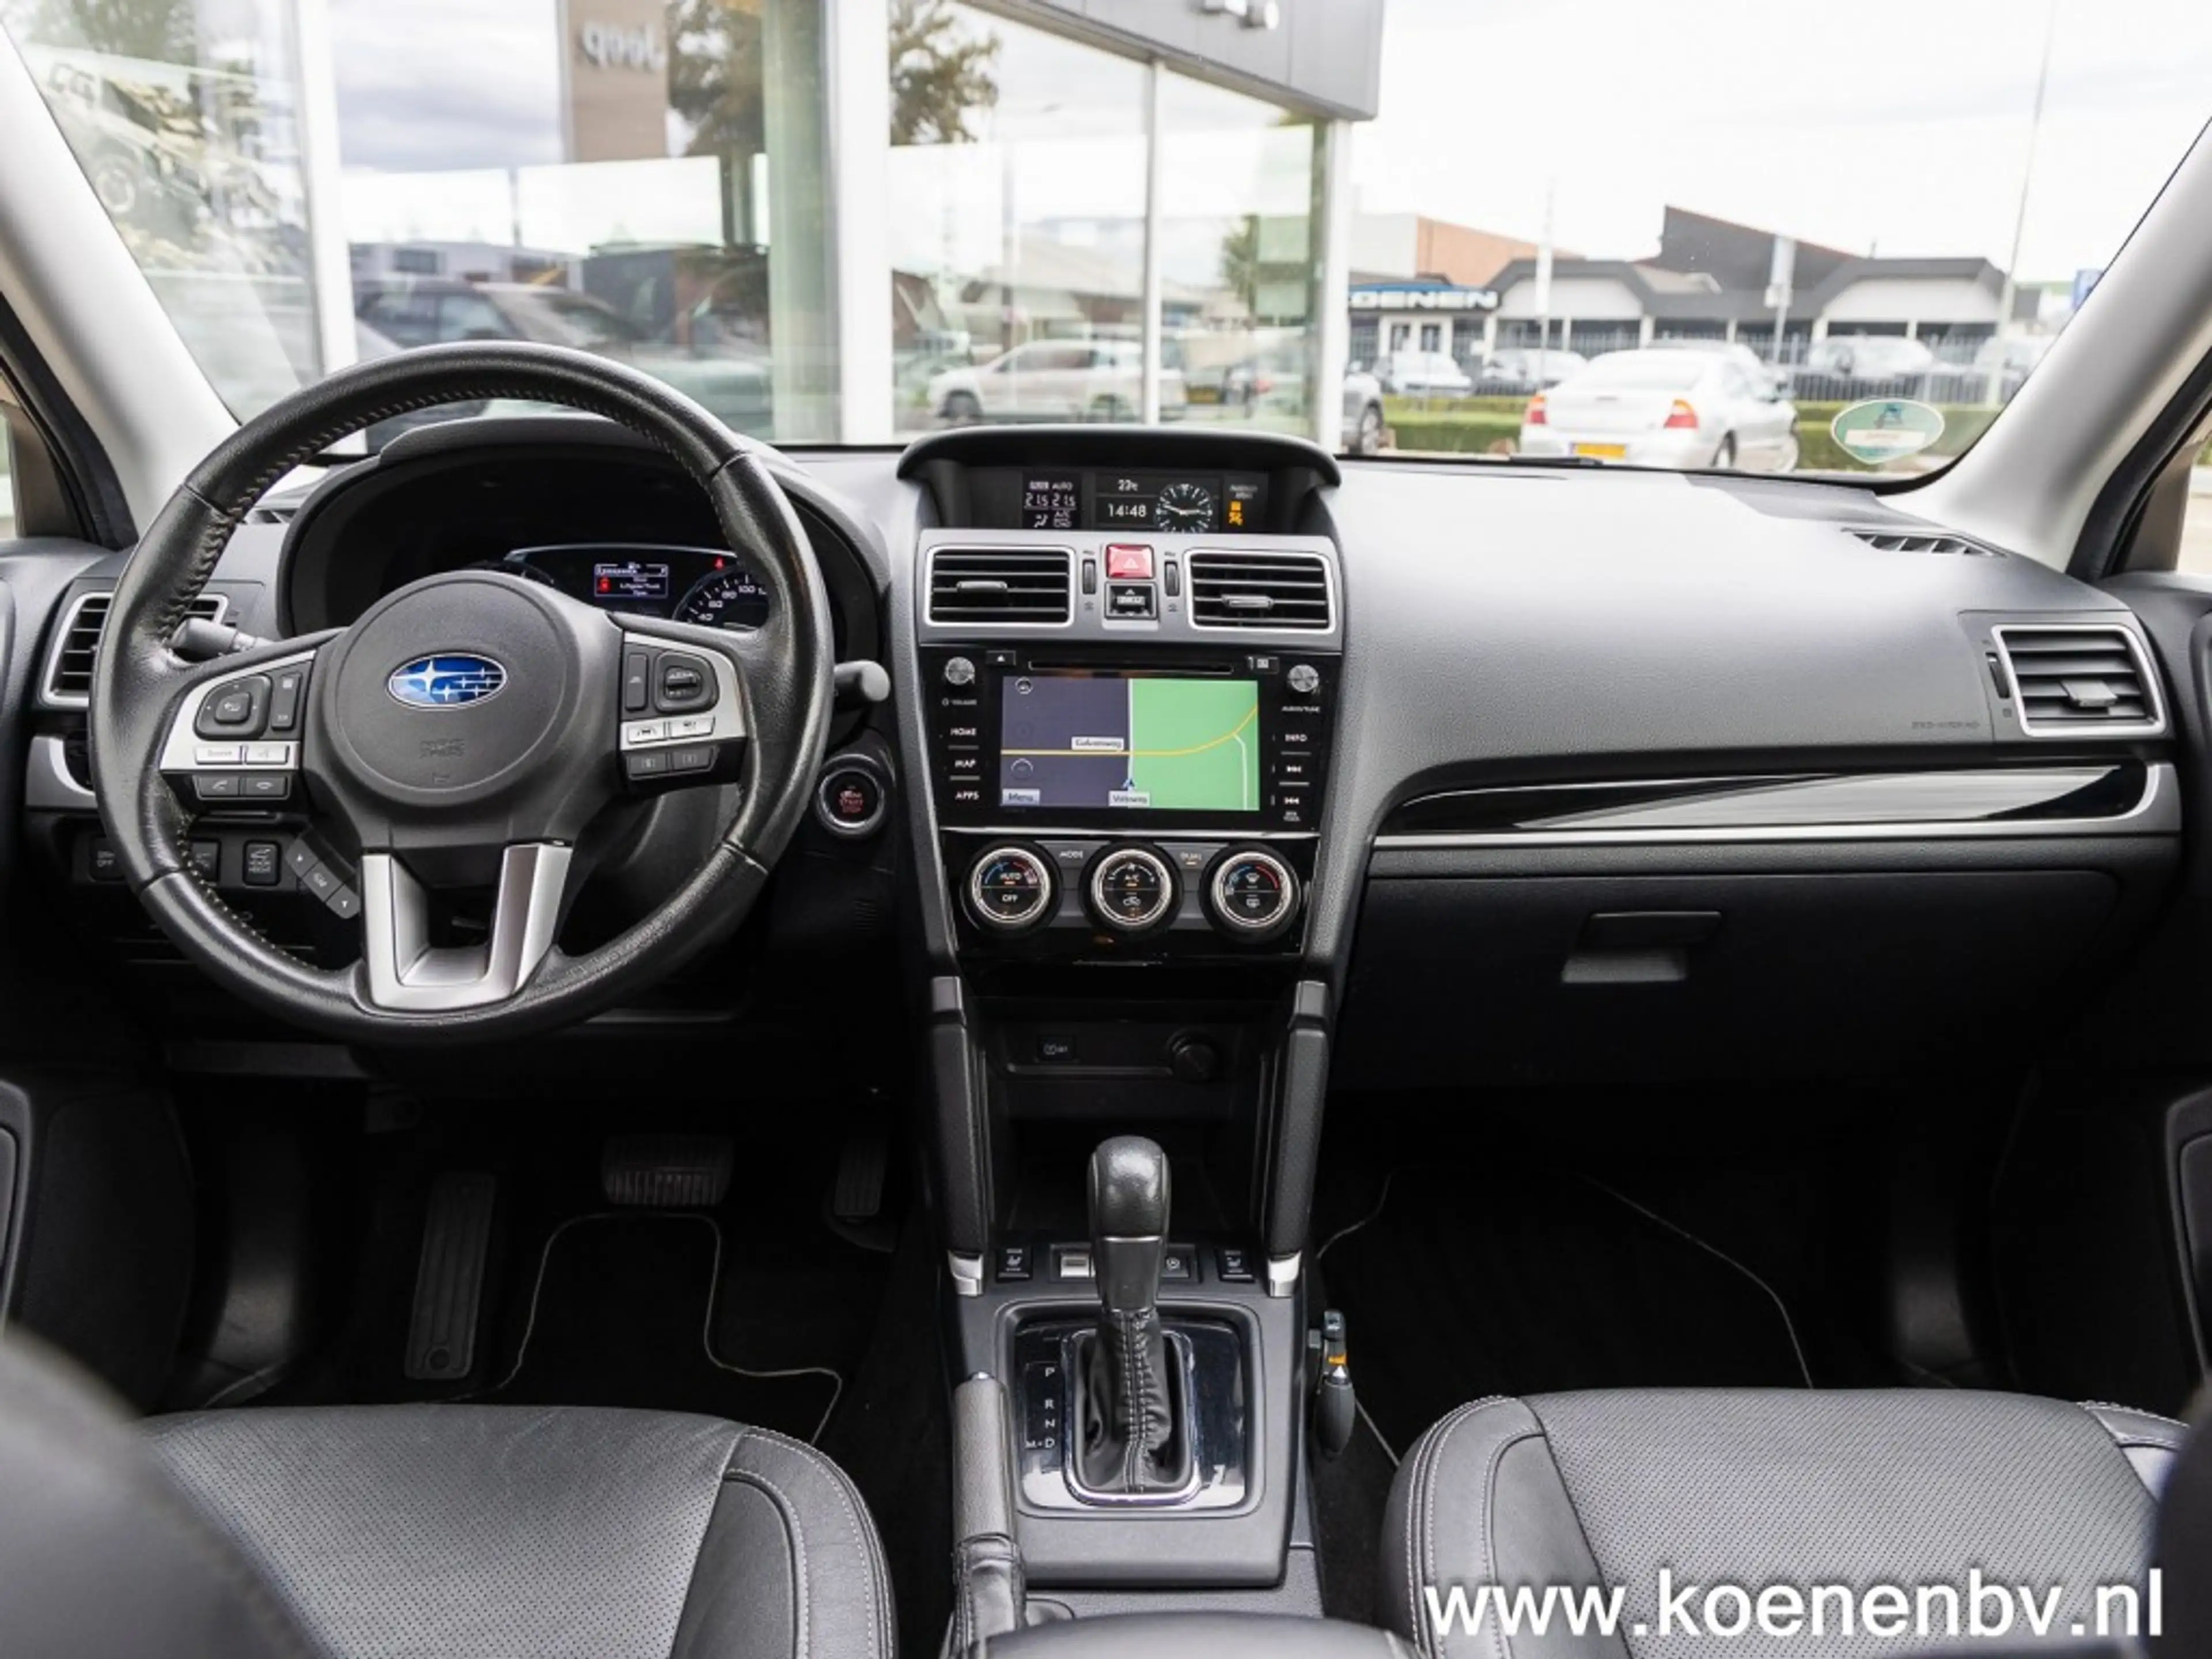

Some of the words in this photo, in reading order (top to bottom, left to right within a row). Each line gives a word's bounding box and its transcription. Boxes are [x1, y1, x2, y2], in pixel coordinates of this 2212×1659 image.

[1108, 503, 1146, 517] 14:48
[1045, 1367, 1055, 1377] P
[1045, 1399, 1055, 1409] R
[1045, 1419, 1055, 1428] N
[1045, 1437, 1055, 1448] D
